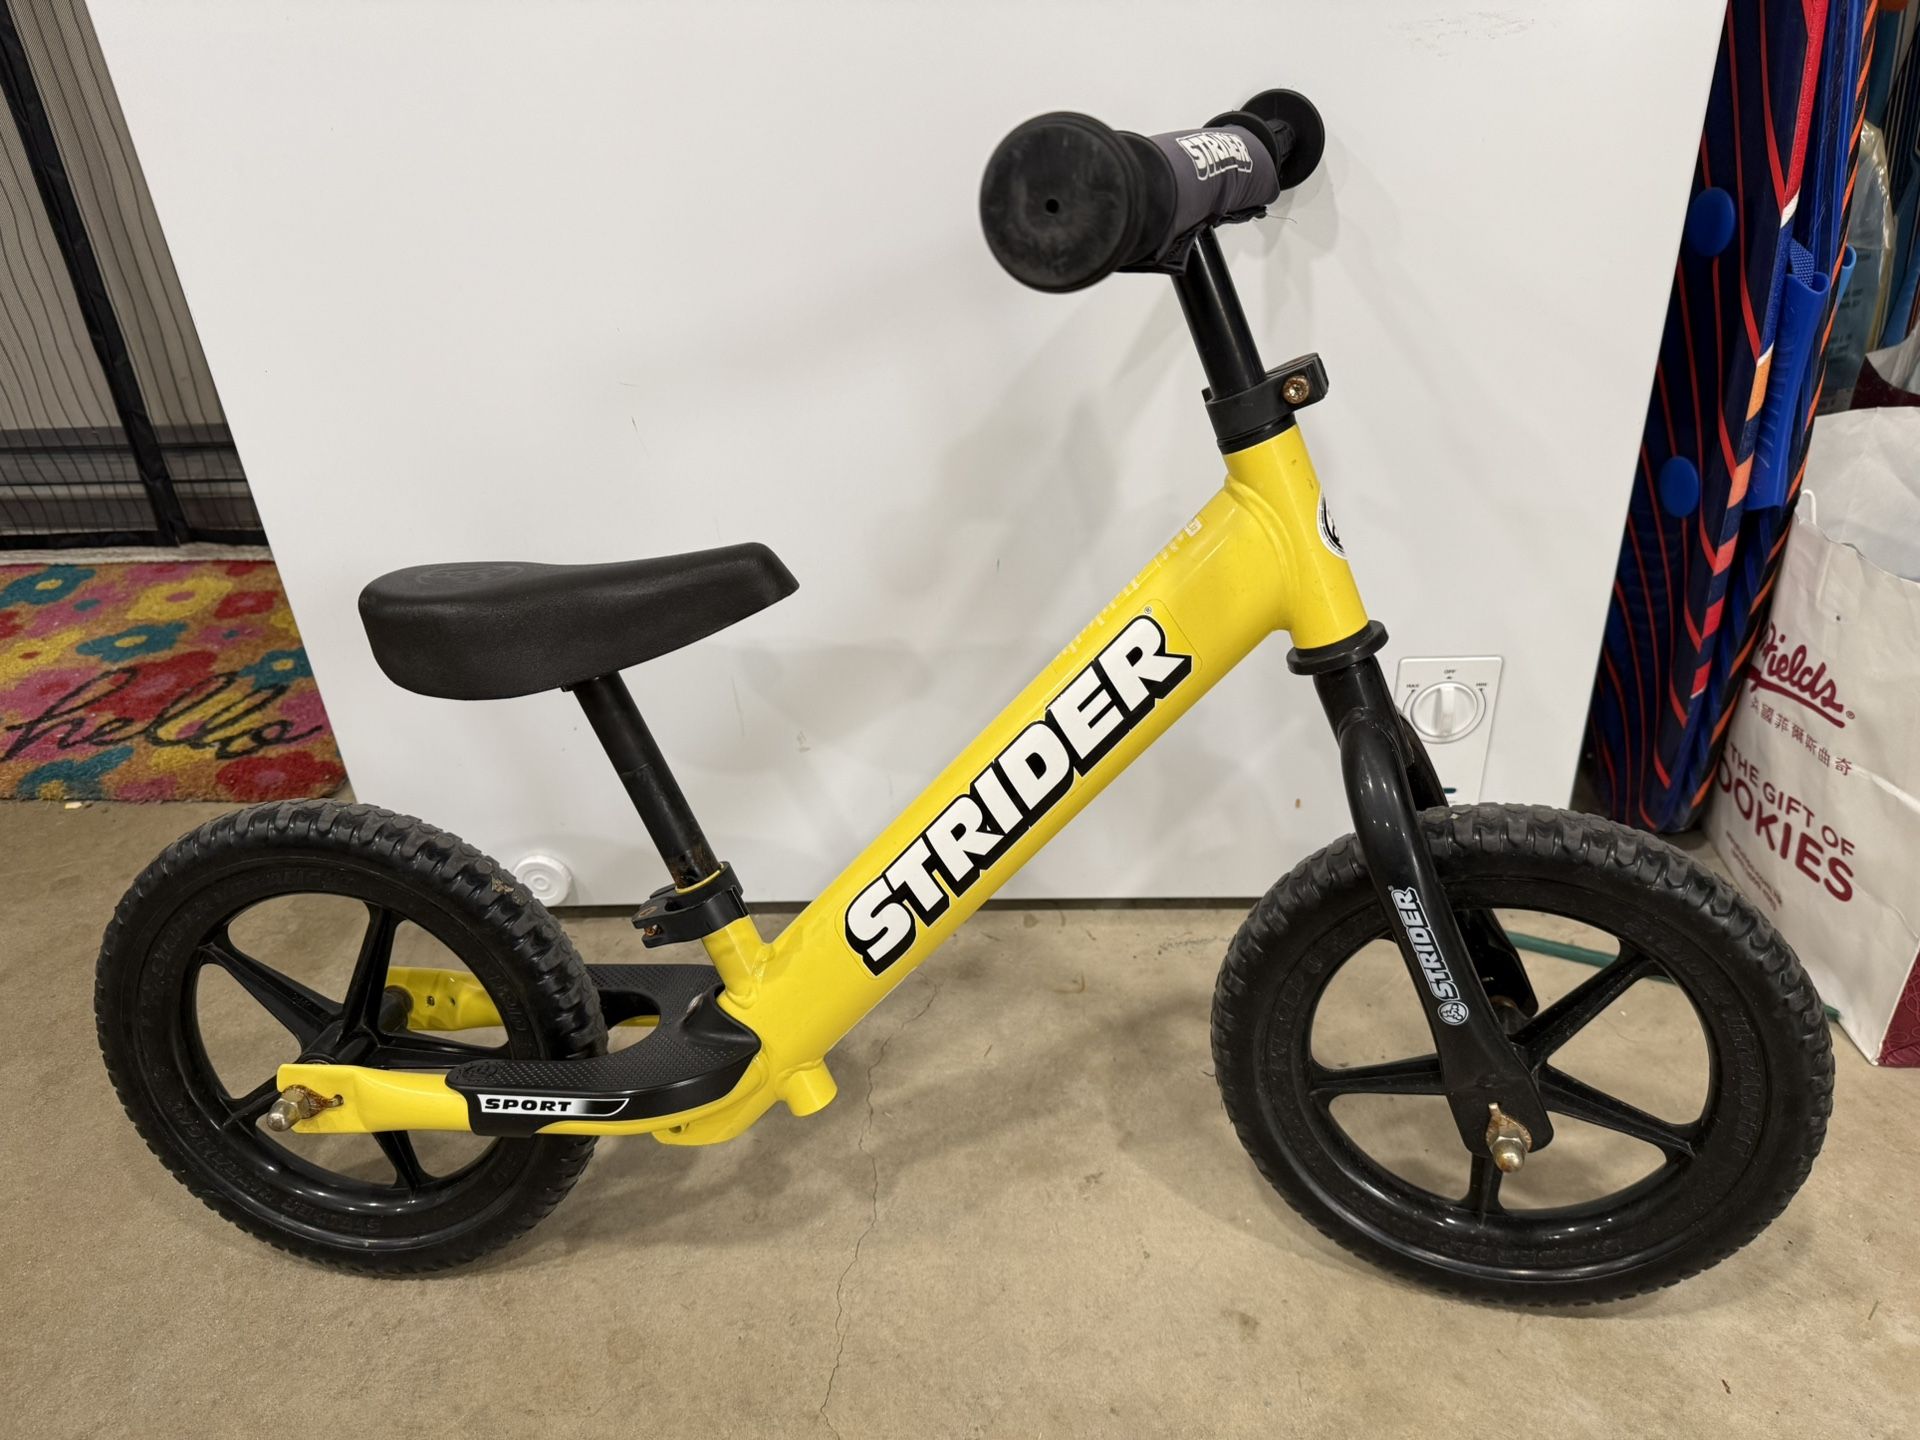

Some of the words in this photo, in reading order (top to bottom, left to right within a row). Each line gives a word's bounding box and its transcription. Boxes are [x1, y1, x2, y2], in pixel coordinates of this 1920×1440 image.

[1178, 132, 1252, 179] STRIDER
[0, 667, 322, 761] hello
[846, 615, 1190, 974] STRIDER
[1717, 756, 1854, 902] OOKIES
[1730, 742, 1759, 788] THE
[1763, 781, 1815, 828] GIFT
[1822, 825, 1855, 856] OF
[1392, 888, 1459, 1001] STRIDER
[484, 1098, 572, 1112] SPORT
